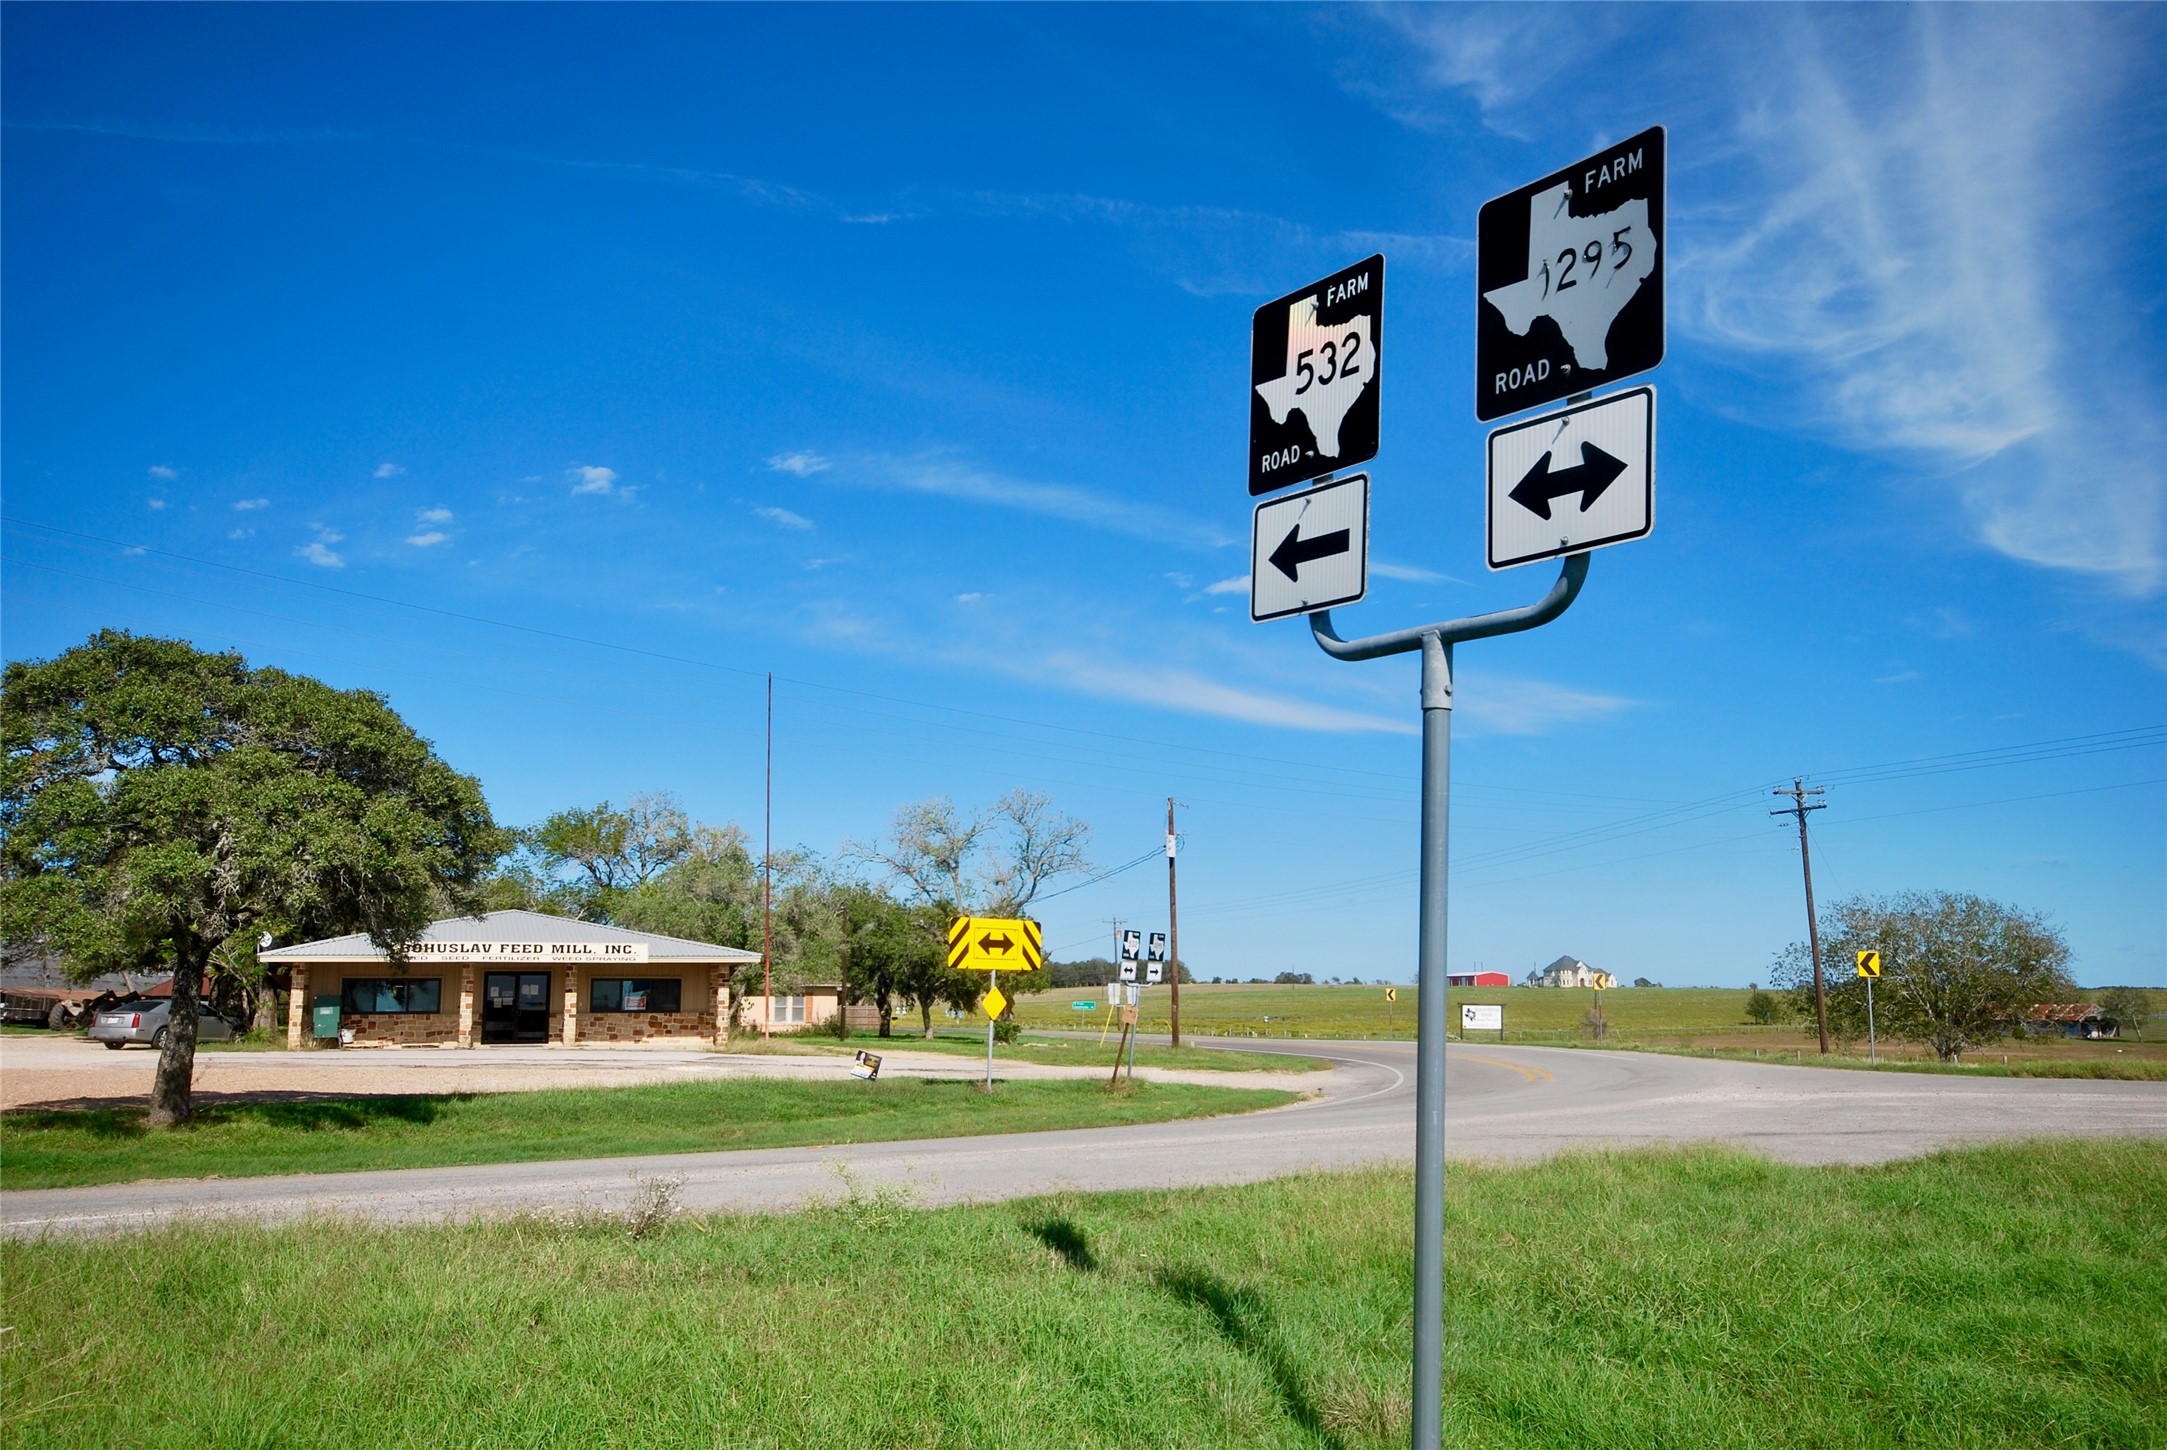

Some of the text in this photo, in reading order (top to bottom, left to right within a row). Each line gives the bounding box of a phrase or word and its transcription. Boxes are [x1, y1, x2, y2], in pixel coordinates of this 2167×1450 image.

[1585, 148, 1643, 193] FARM
[1541, 226, 1632, 301] 1295
[1327, 271, 1369, 307] FARM
[1295, 331, 1361, 396] 532
[1495, 358, 1551, 395] ROAD
[1261, 444, 1300, 473] ROAD
[401, 943, 492, 954] BOHUSLAV
[500, 943, 544, 954] FEED
[605, 944, 637, 955] INC.
